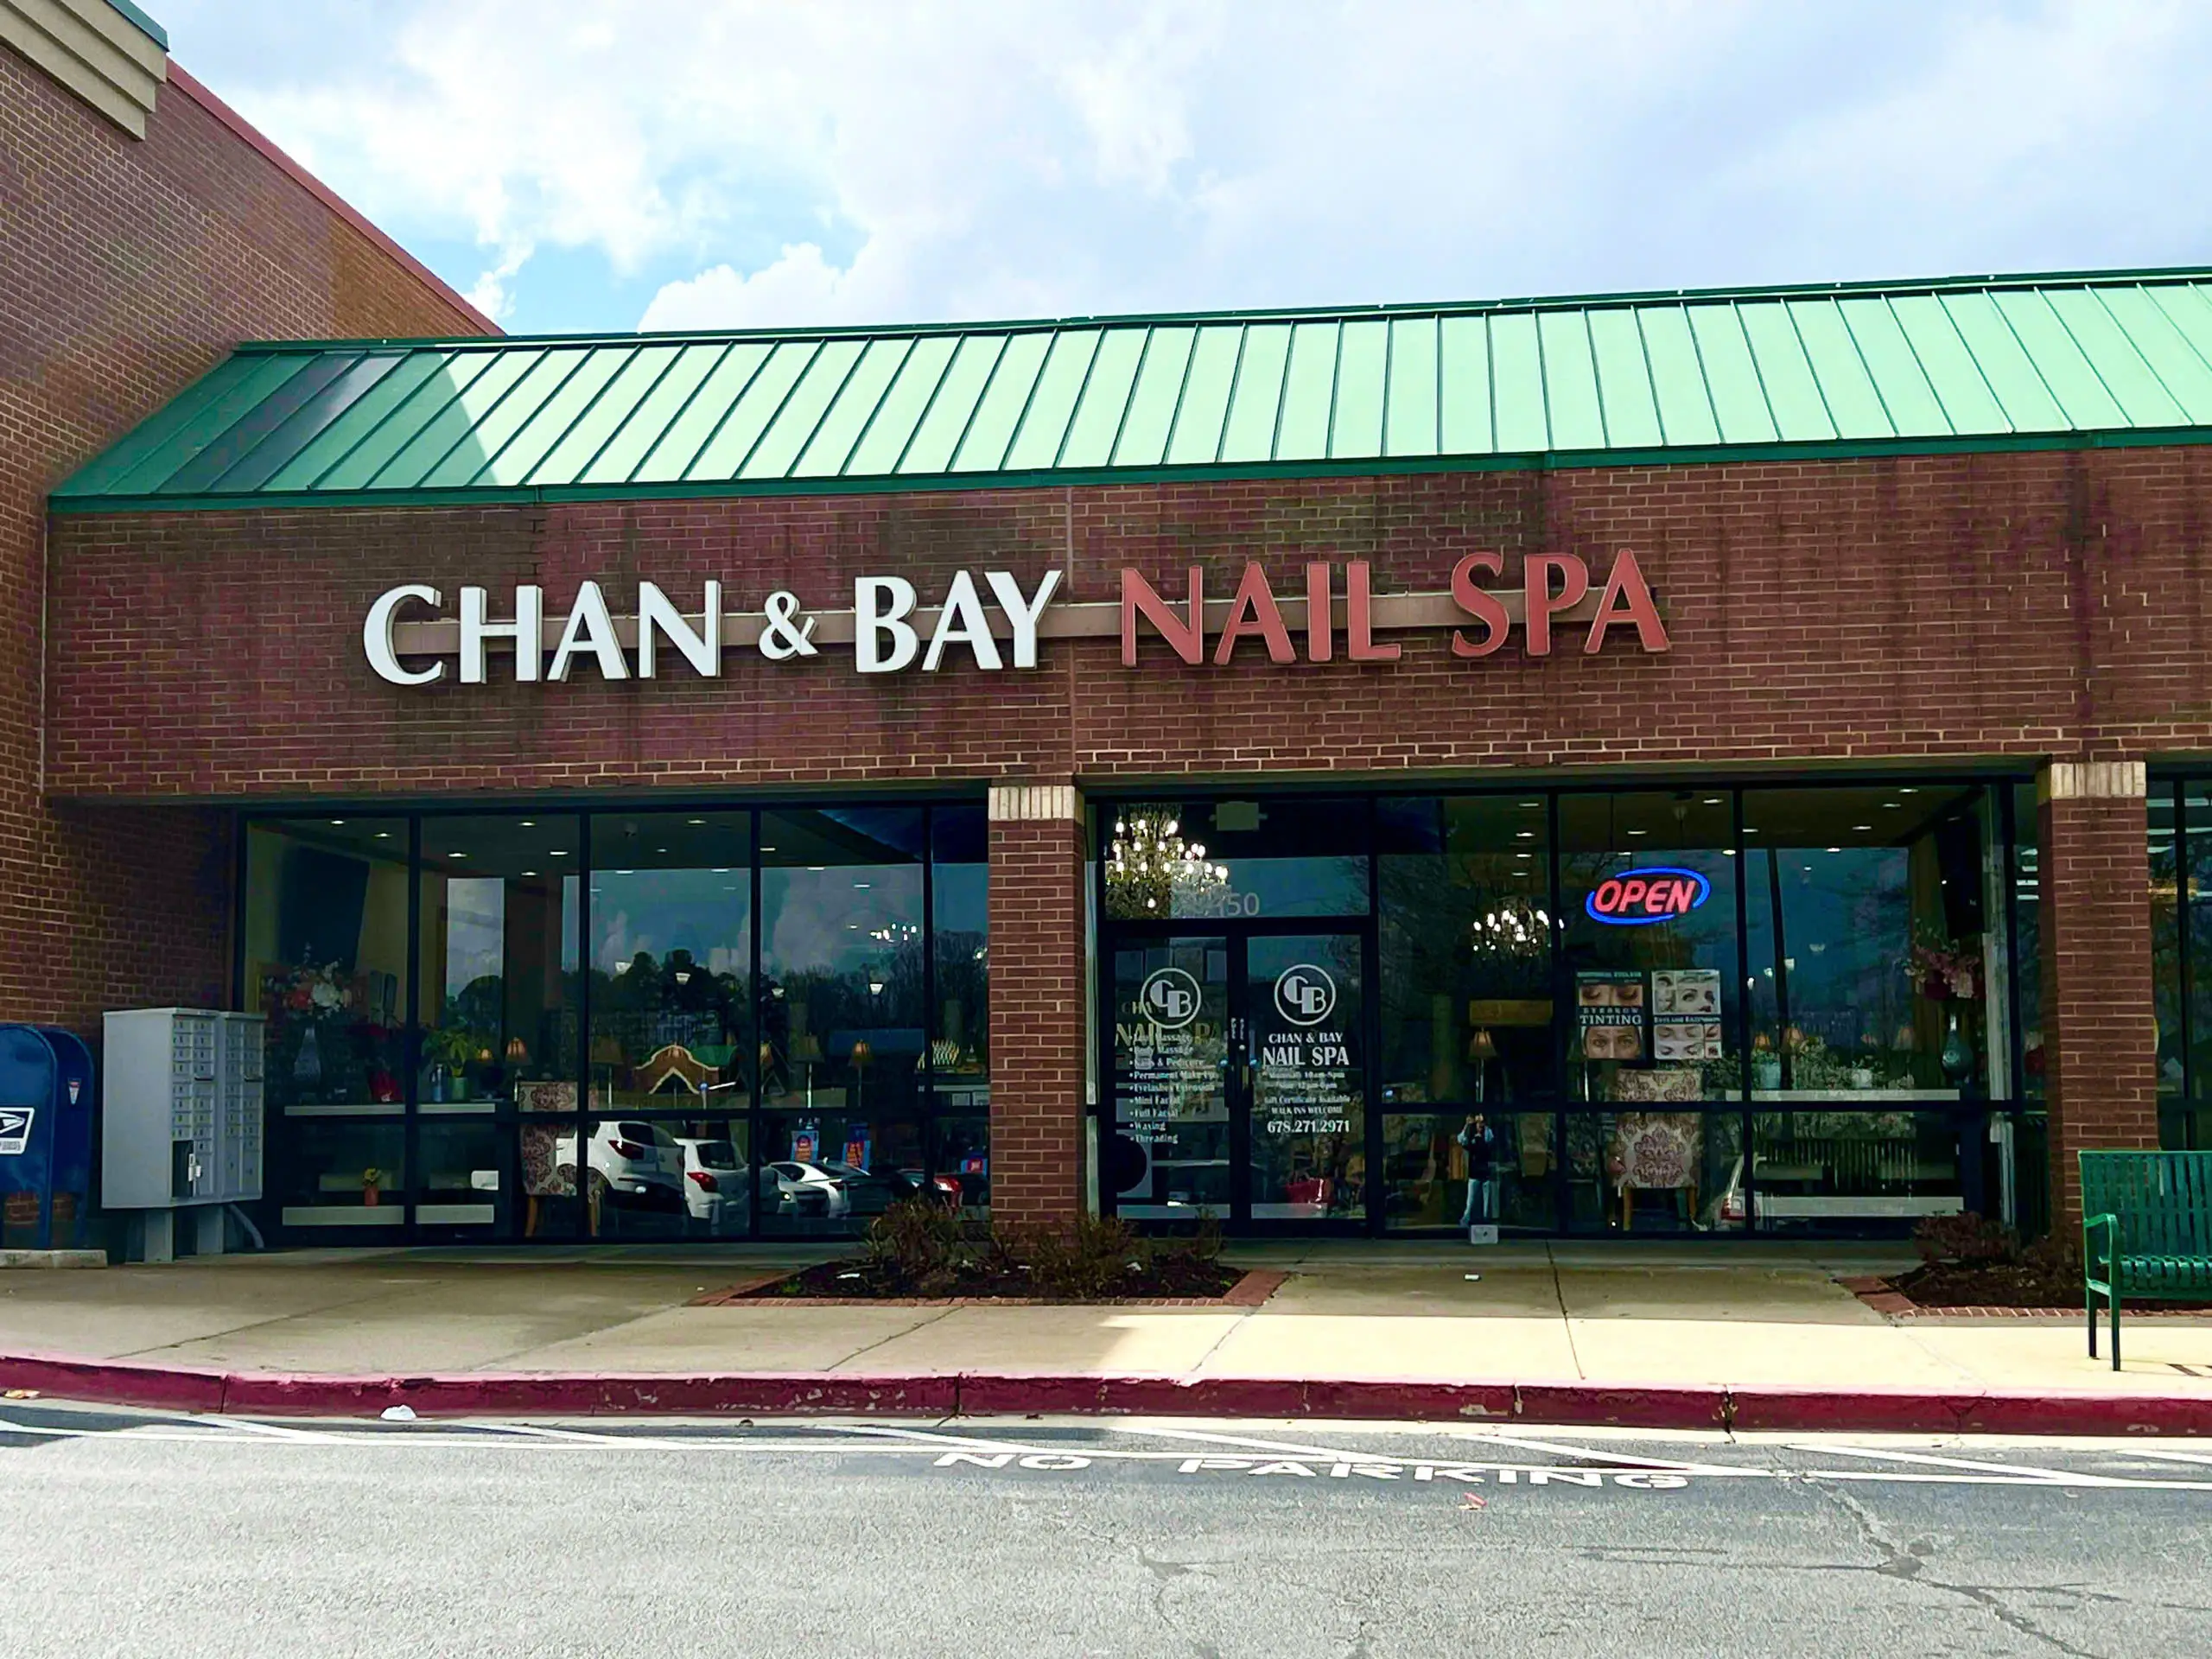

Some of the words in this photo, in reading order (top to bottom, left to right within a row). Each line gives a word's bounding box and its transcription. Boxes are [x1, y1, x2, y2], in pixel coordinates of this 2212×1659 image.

[363, 580, 721, 684] CHAN
[759, 590, 818, 661] &
[855, 569, 1064, 673] BAY
[1122, 560, 1402, 666] NAIL
[1451, 548, 1669, 658] SPA
[1594, 880, 1697, 912] OPEN
[1580, 1014, 1642, 1025] TINTING
[1268, 1033, 1302, 1044] CHAN
[1306, 1033, 1314, 1043] &
[1319, 1032, 1343, 1043] BAY
[1262, 1046, 1306, 1066] NAIL
[1312, 1046, 1350, 1066] SPA
[1267, 1119, 1350, 1134] 678.271.2971
[1135, 1135, 1178, 1144] Threading
[933, 1452, 1092, 1470] NO
[1178, 1458, 1689, 1490] PARKING
